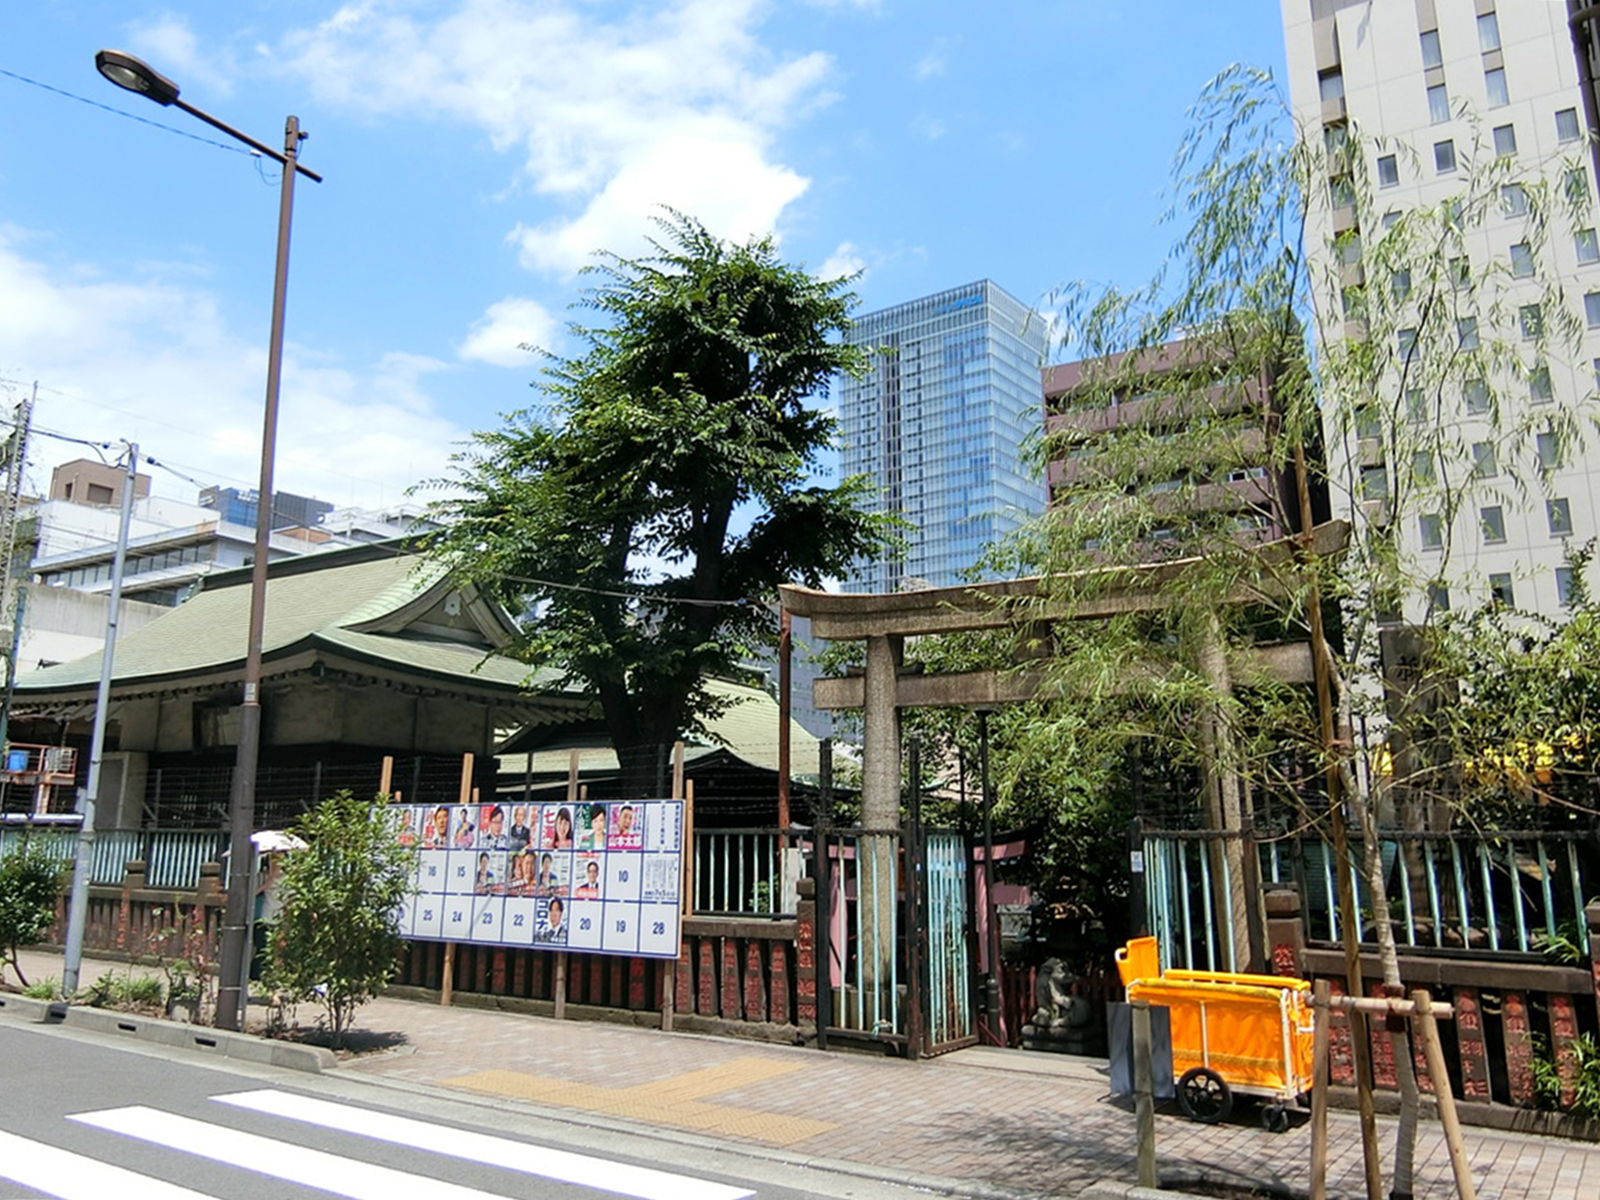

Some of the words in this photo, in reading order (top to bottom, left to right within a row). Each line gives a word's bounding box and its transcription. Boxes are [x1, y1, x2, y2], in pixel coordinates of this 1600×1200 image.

[457, 866, 466, 877] 15
[618, 870, 629, 882] 10
[423, 909, 433, 921] 25
[452, 911, 462, 922] 24
[482, 912, 493, 924] 23
[513, 914, 524, 926] 22
[580, 918, 591, 930] 20
[616, 920, 626, 932] 19
[652, 921, 665, 935] 28
